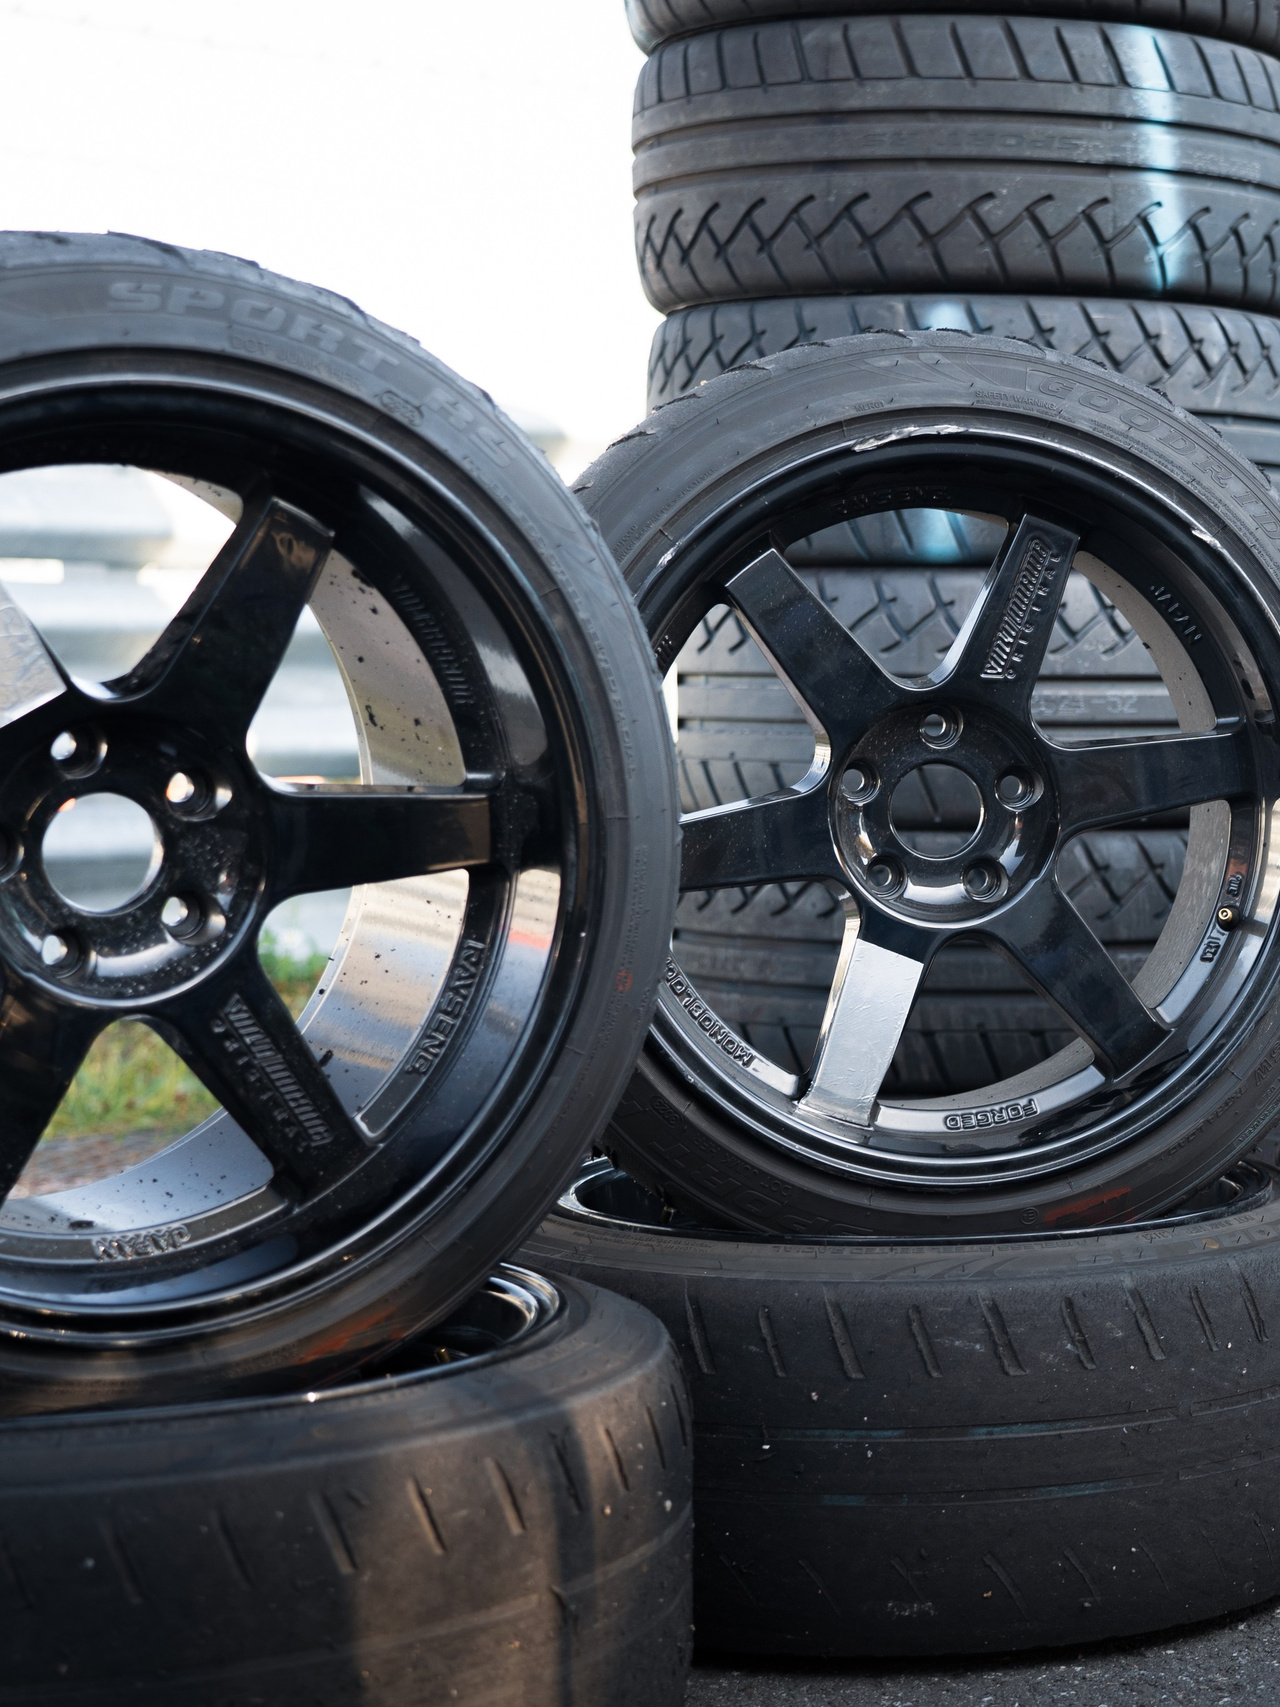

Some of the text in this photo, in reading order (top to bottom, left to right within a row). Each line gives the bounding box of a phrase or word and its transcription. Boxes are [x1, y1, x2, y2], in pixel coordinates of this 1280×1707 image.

[108, 281, 401, 371] SPORT
[426, 386, 518, 469] RS
[974, 389, 1011, 402] SAFETY
[664, 956, 754, 1069] MONOBLOC
[1260, 1083, 1277, 1103] USE
[943, 1098, 1040, 1132] FORGED
[92, 1224, 192, 1264] JAPAN
